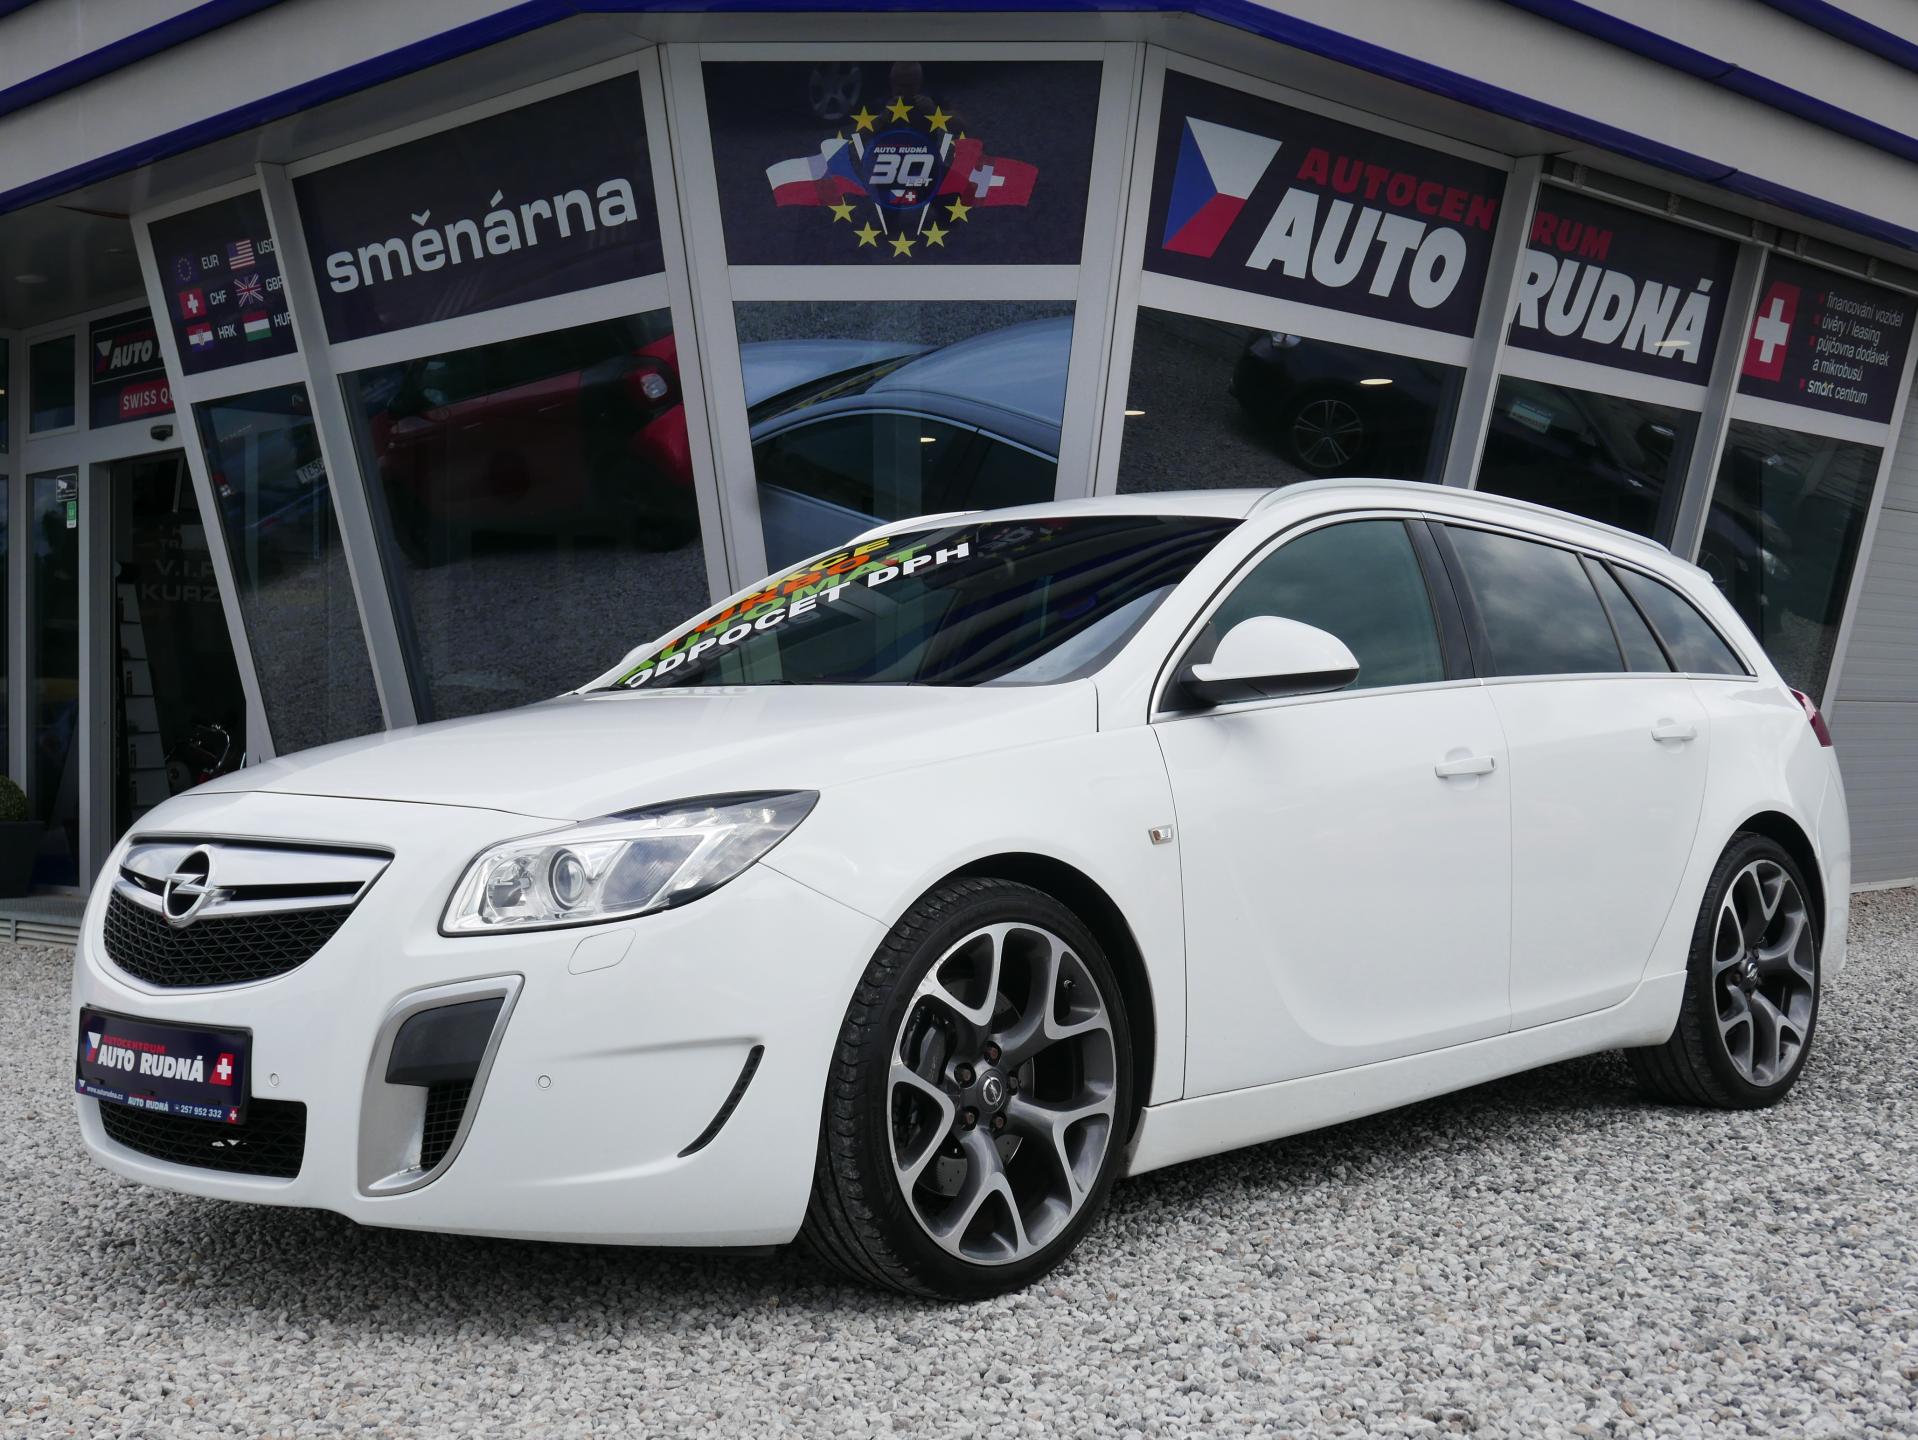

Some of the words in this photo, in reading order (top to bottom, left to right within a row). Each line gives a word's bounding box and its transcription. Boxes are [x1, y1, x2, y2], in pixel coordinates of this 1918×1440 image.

[874, 146, 896, 154] AUTO
[899, 145, 928, 154] RUDNÁ
[869, 153, 935, 185] 30
[905, 177, 933, 187] LET
[326, 178, 638, 293] směnárna
[201, 254, 221, 270] EUR
[1245, 187, 1467, 309] AUTO
[1510, 247, 1714, 365] RUDNÁ
[209, 289, 228, 305] CHF
[1875, 304, 1904, 328] vozidel
[217, 323, 237, 340] HRK
[1851, 320, 1881, 346] leasing
[109, 339, 154, 370] AUTO
[1812, 359, 1818, 371] a
[1855, 344, 1891, 367] dodávek
[123, 389, 157, 410] SWISS
[1807, 378, 1834, 398] smart
[1834, 385, 1868, 405] centrum
[867, 542, 970, 588] DPH
[97, 1044, 135, 1072] AUTO
[139, 1052, 204, 1083] RUDNÁ
[127, 1096, 144, 1107] AUTO
[145, 1099, 169, 1112] RUDNÁ
[180, 1104, 193, 1114] 257
[194, 1106, 208, 1116] 952
[208, 1108, 222, 1118] 332
